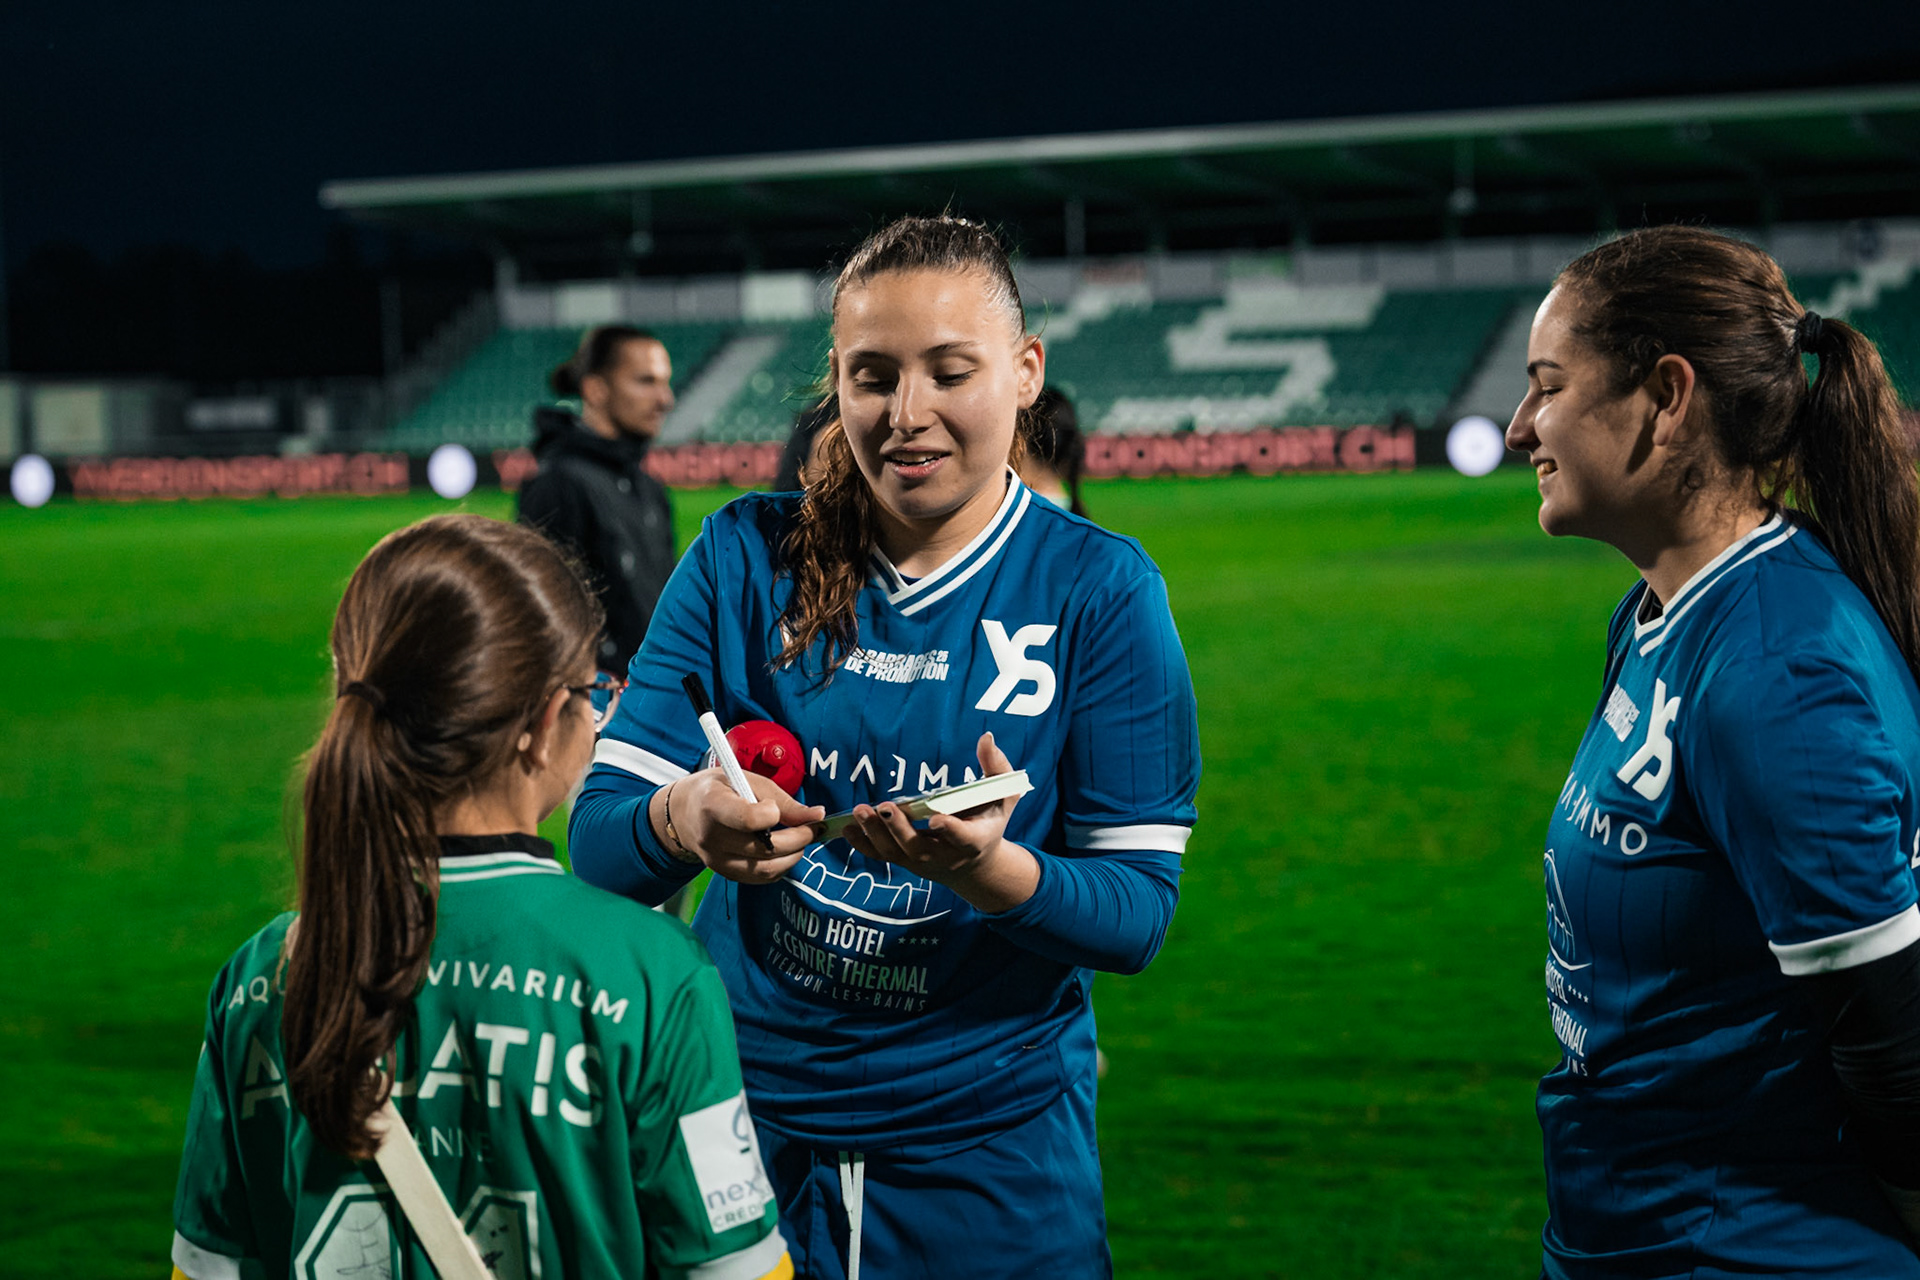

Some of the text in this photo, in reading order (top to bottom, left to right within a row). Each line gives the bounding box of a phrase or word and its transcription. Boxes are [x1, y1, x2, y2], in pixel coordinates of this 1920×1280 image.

[844, 655, 950, 684] DE PROMOTION
[974, 619, 1057, 717] YS
[773, 922, 929, 995] & CENTRE THERMAL
[781, 890, 885, 959] GRAND HÔTEL
[428, 960, 629, 1024] VIVARIUM
[241, 1020, 600, 1127] AUATIS
